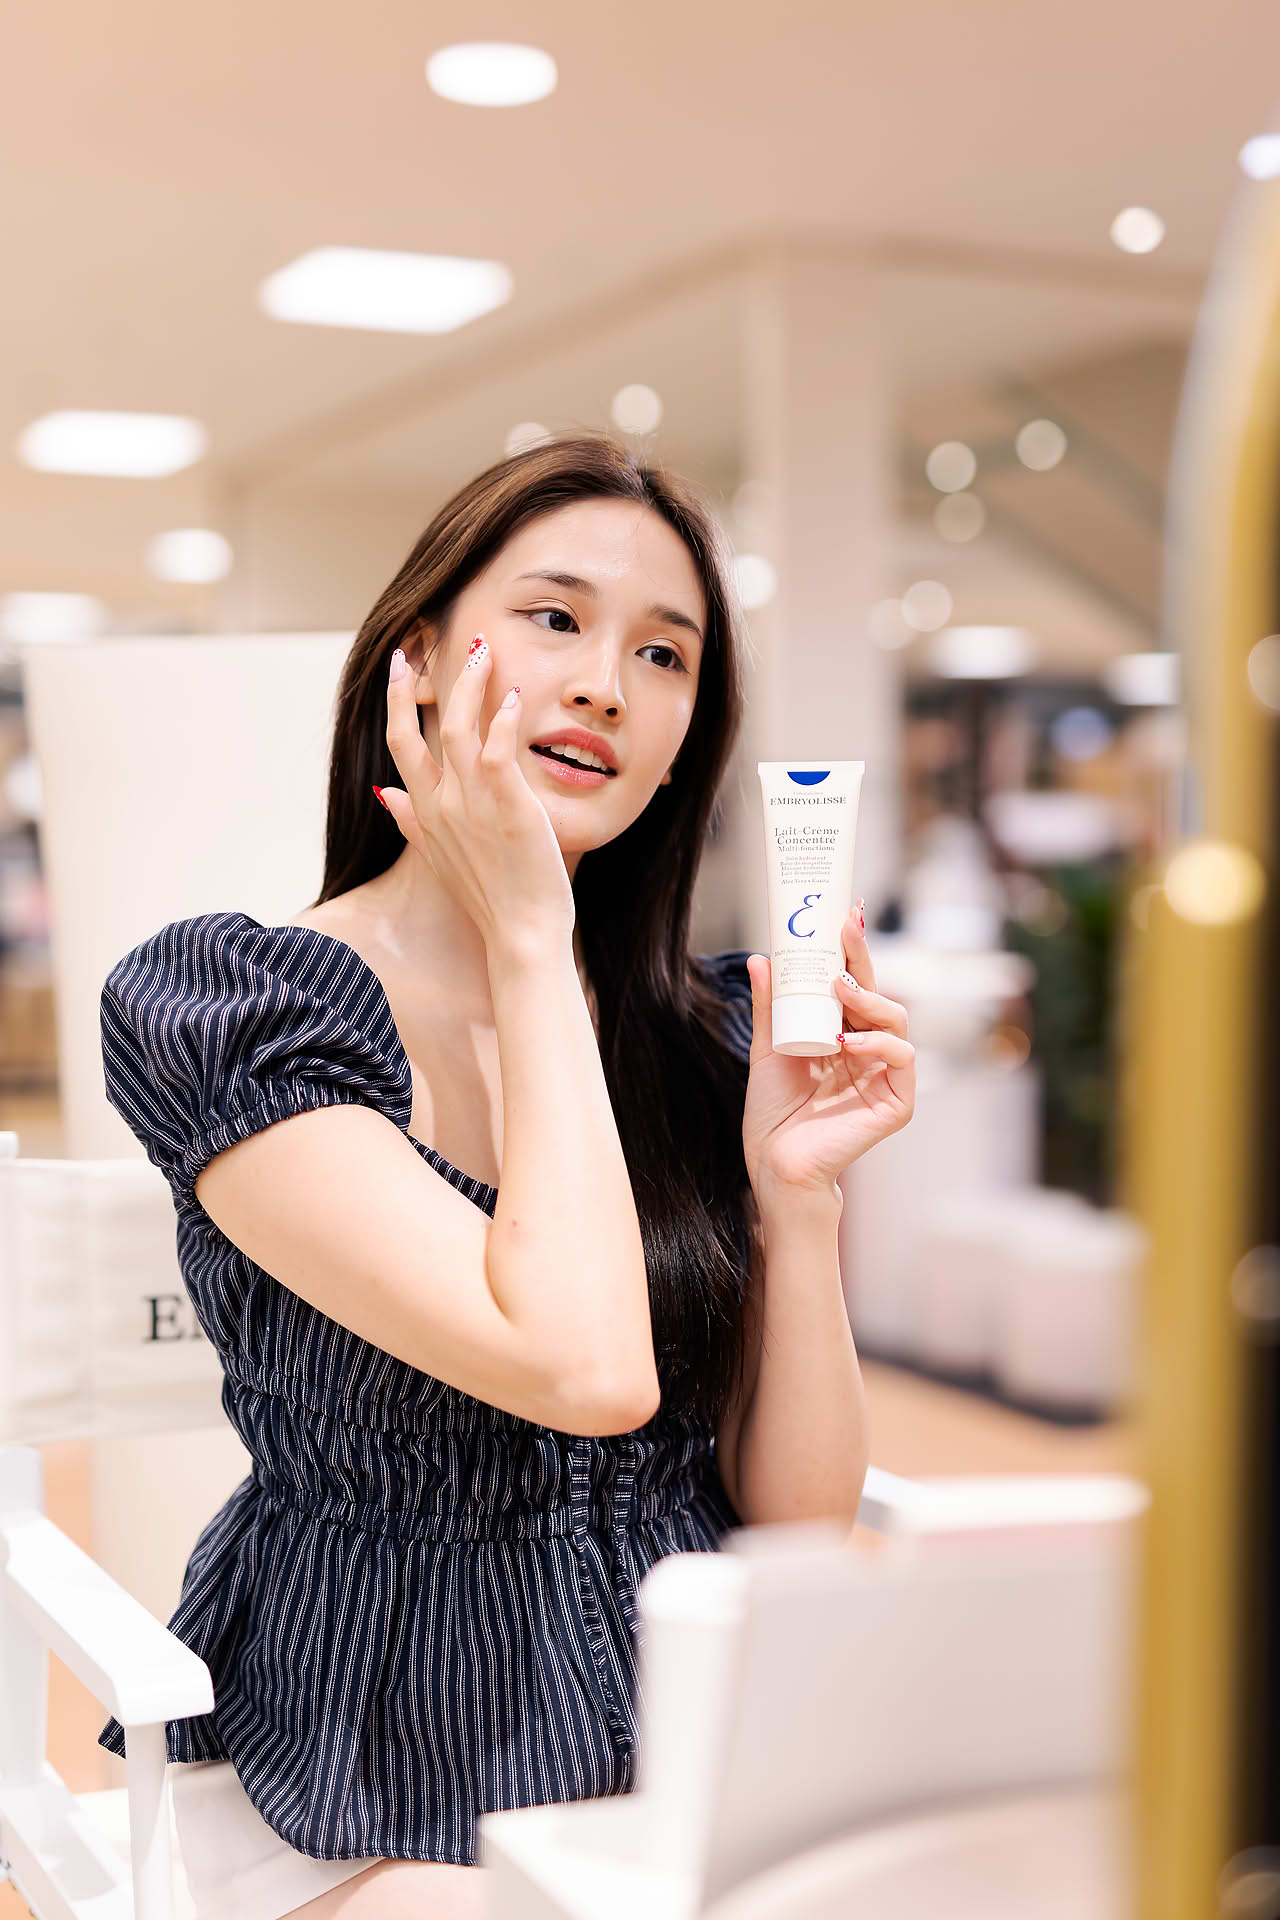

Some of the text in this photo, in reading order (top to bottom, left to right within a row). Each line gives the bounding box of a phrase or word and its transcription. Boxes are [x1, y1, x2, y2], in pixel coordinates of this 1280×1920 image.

[770, 796, 847, 806] EMBRYOLISSE
[777, 836, 836, 845] Concentré
[142, 1293, 203, 1344] E
